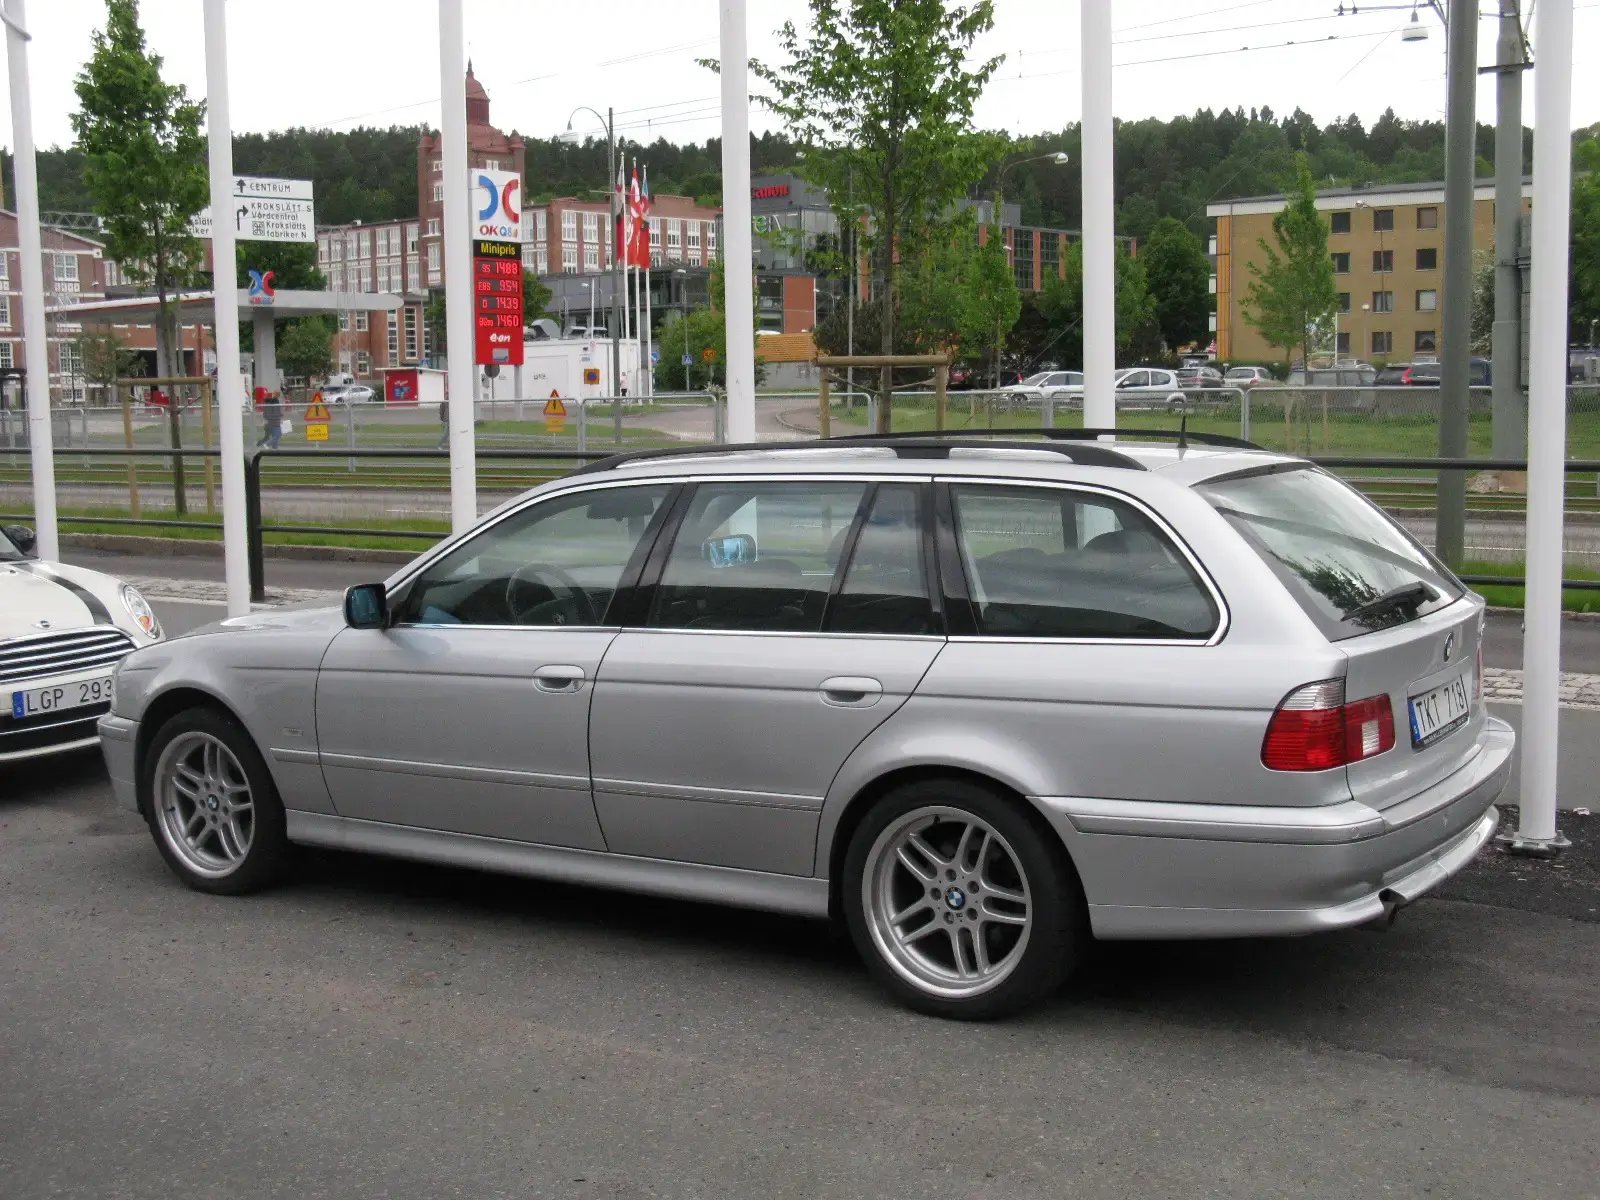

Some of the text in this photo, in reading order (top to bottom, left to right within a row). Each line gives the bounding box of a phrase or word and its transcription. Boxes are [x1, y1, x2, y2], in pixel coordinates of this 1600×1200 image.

[250, 183, 291, 193] CENTRUM
[251, 202, 312, 213] KROKSLÄTT S
[301, 231, 307, 239] N
[481, 242, 516, 256] Minipris
[27, 679, 112, 712] LGP 293
[1416, 694, 1441, 732] TKT
[1443, 681, 1465, 717] 718
